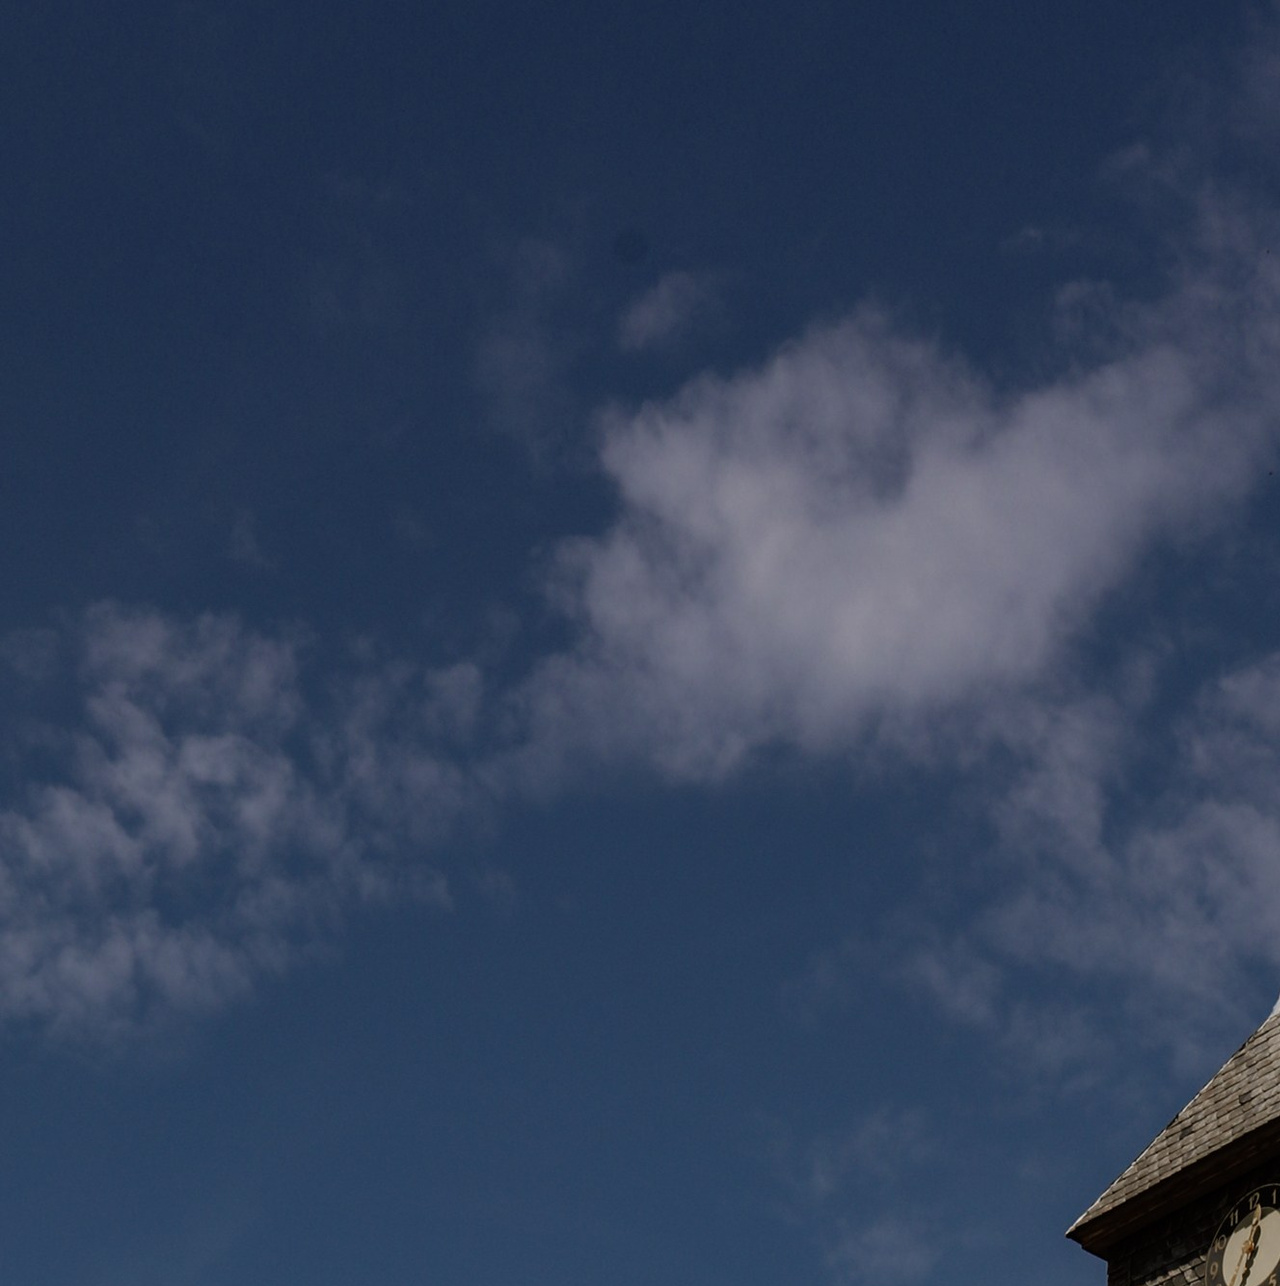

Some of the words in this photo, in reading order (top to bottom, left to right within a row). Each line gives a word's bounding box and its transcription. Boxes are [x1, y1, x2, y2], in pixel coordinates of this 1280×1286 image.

[1248, 1192, 1260, 1210] 12
[1272, 1189, 1277, 1204] 1
[1230, 1209, 1238, 1226] 11
[1214, 1234, 1227, 1252] 10
[1210, 1262, 1218, 1280] 9
